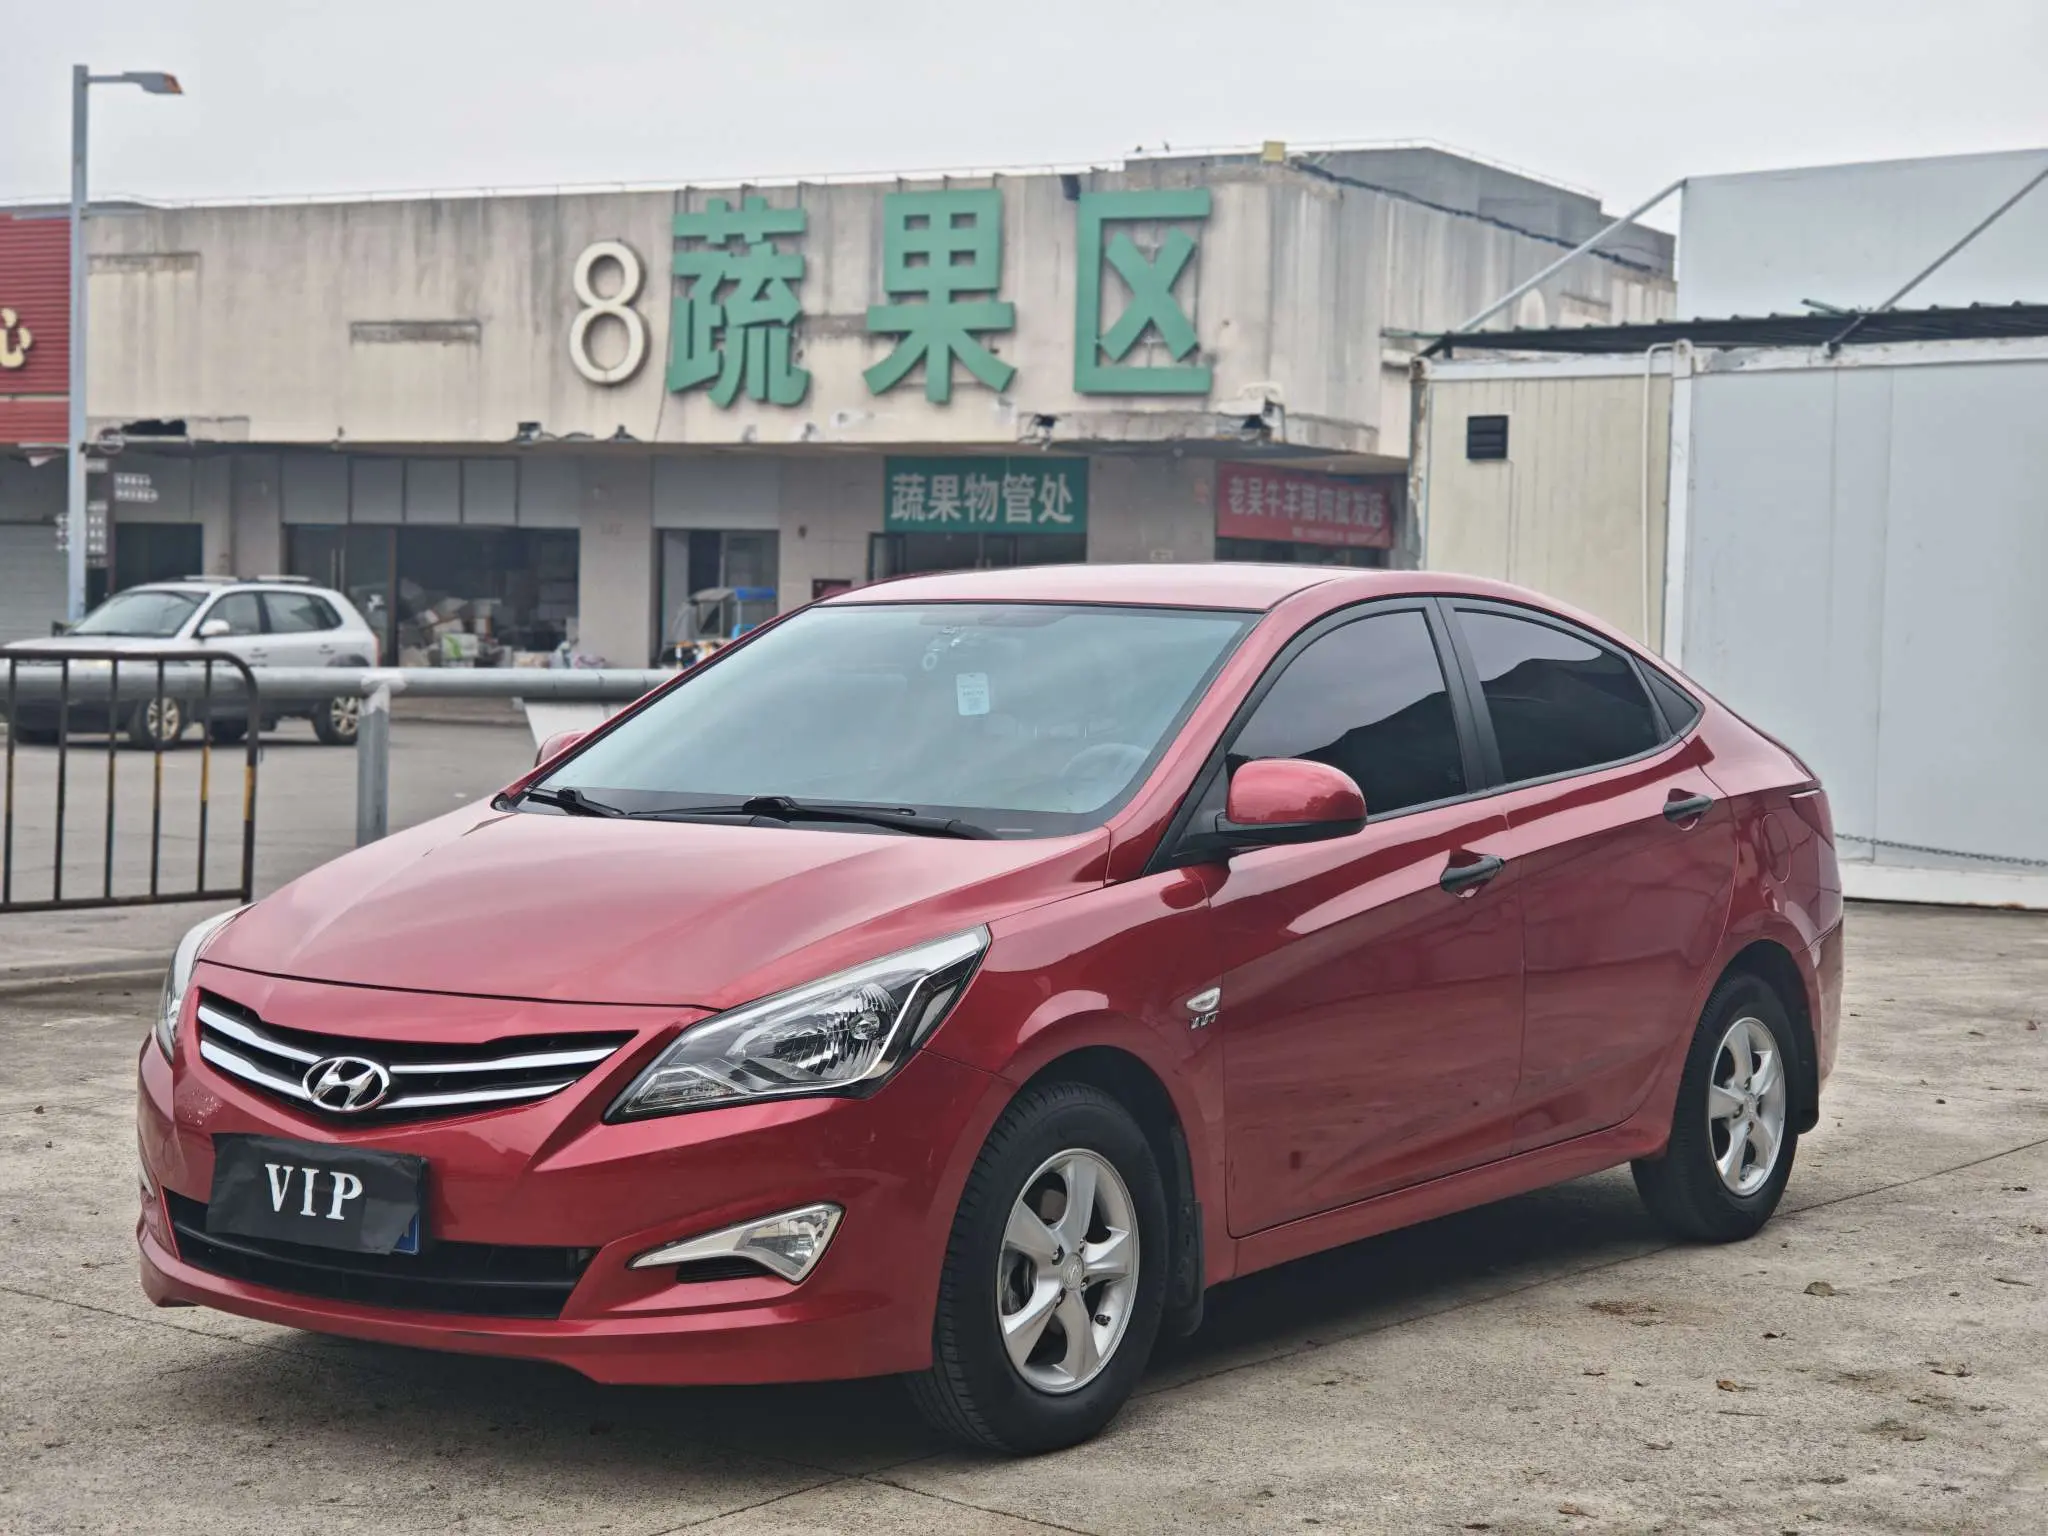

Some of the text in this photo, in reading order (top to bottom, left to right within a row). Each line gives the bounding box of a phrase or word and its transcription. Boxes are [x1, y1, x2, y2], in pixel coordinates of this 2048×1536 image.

[569, 240, 645, 384] 8
[667, 188, 1212, 408] 蔬果区
[890, 472, 1074, 524] 蔬果物管处
[264, 1163, 363, 1221] VIP
